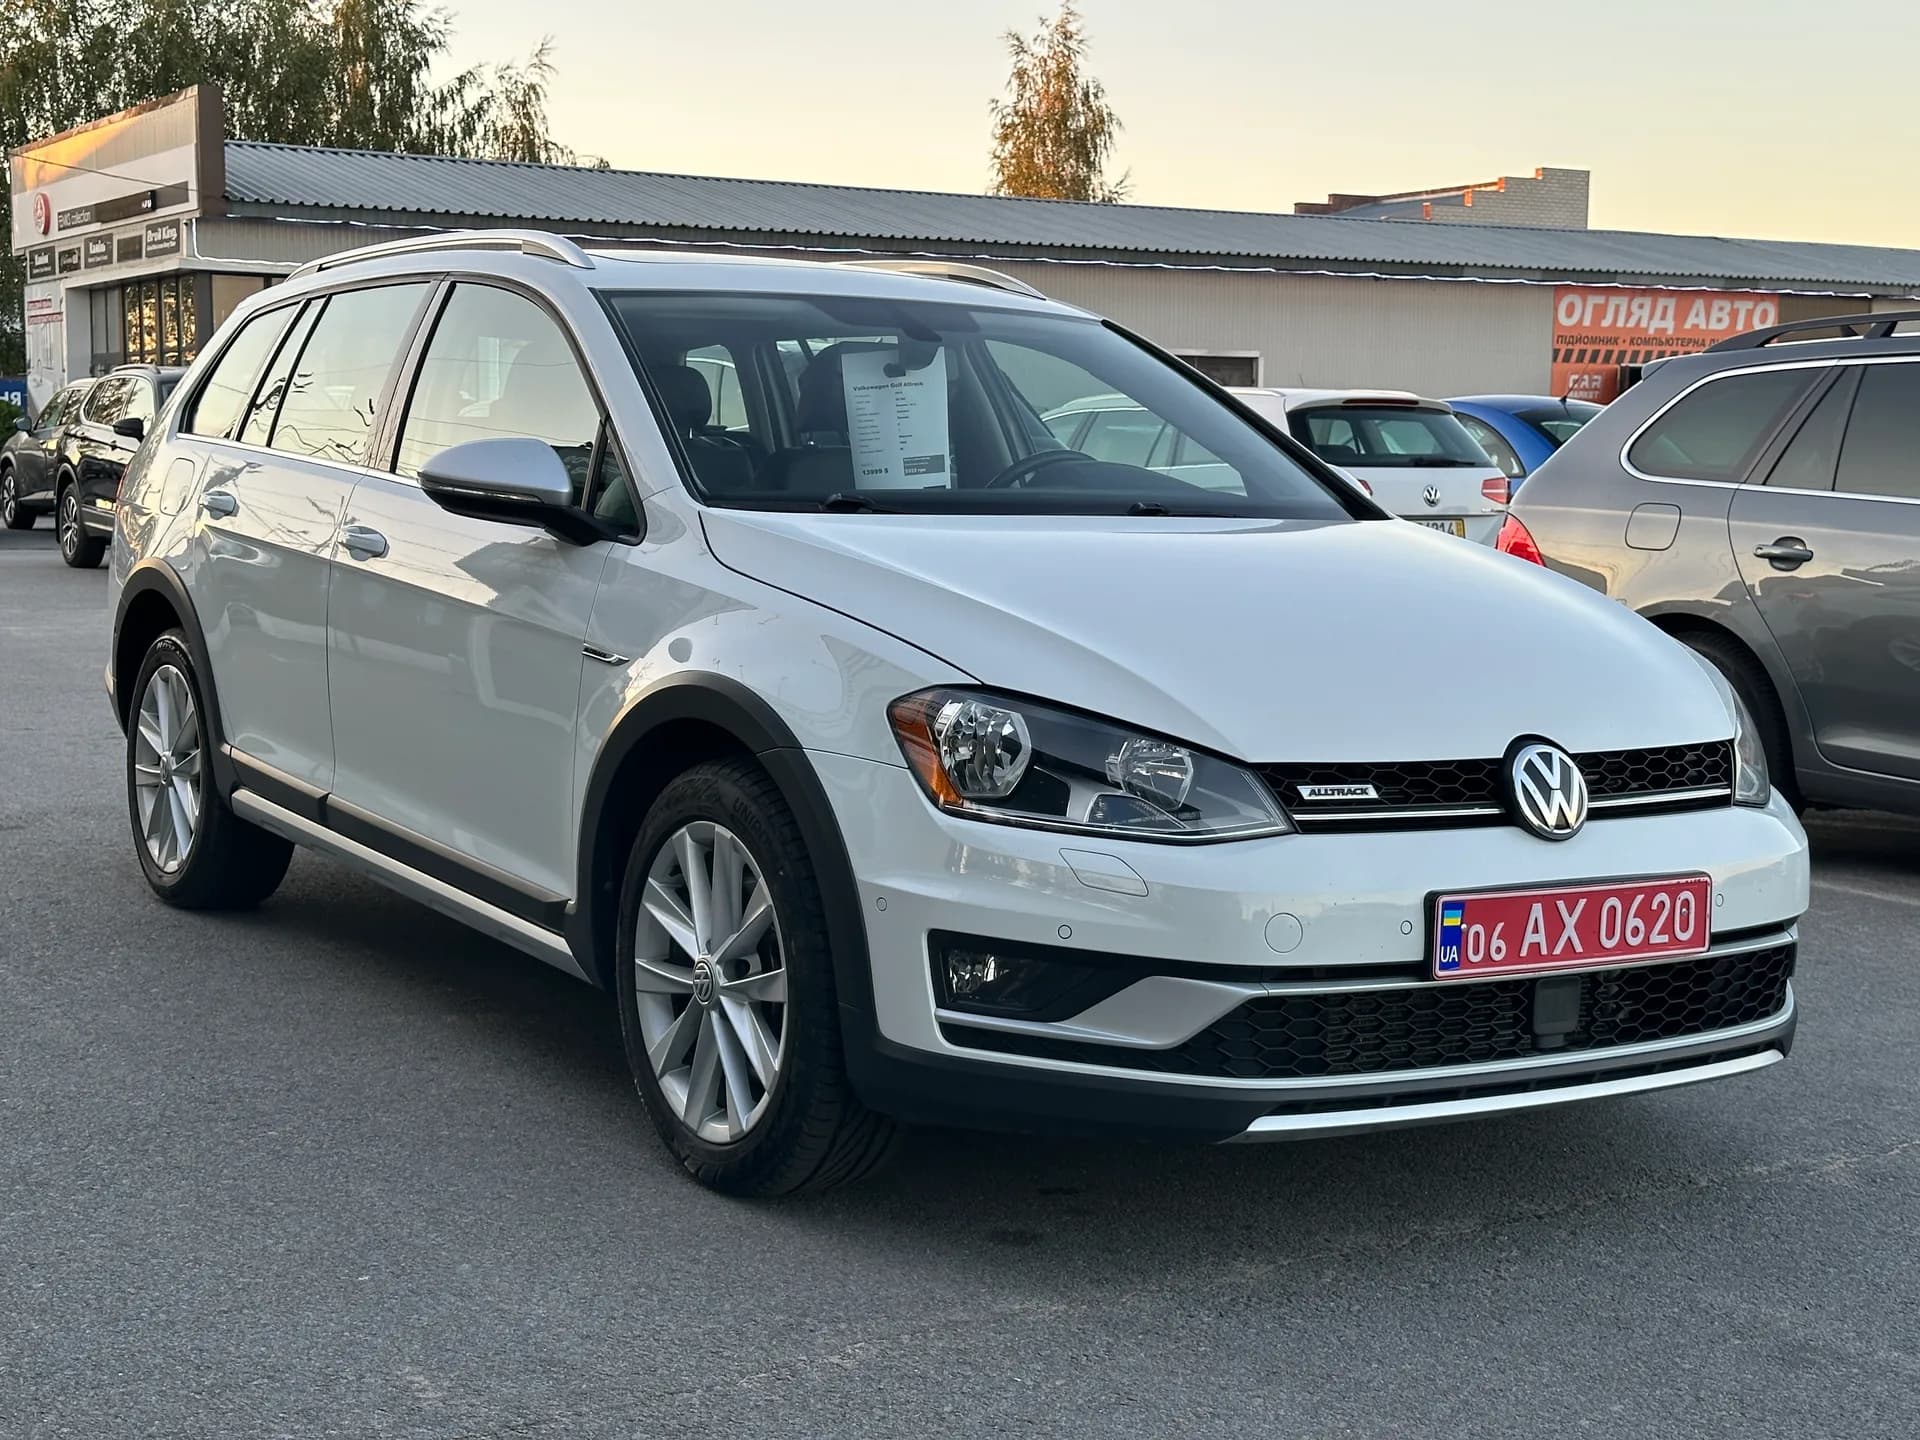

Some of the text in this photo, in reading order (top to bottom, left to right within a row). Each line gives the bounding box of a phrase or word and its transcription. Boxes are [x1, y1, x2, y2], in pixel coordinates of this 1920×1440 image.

[1557, 294, 1776, 335] ОГЛЯД АВТО
[1556, 333, 1619, 346] ПІДЙОМНИК
[1308, 786, 1370, 798] ALLTRACK
[1467, 890, 1696, 963] 06 AX 0620
[1440, 945, 1458, 963] UA
